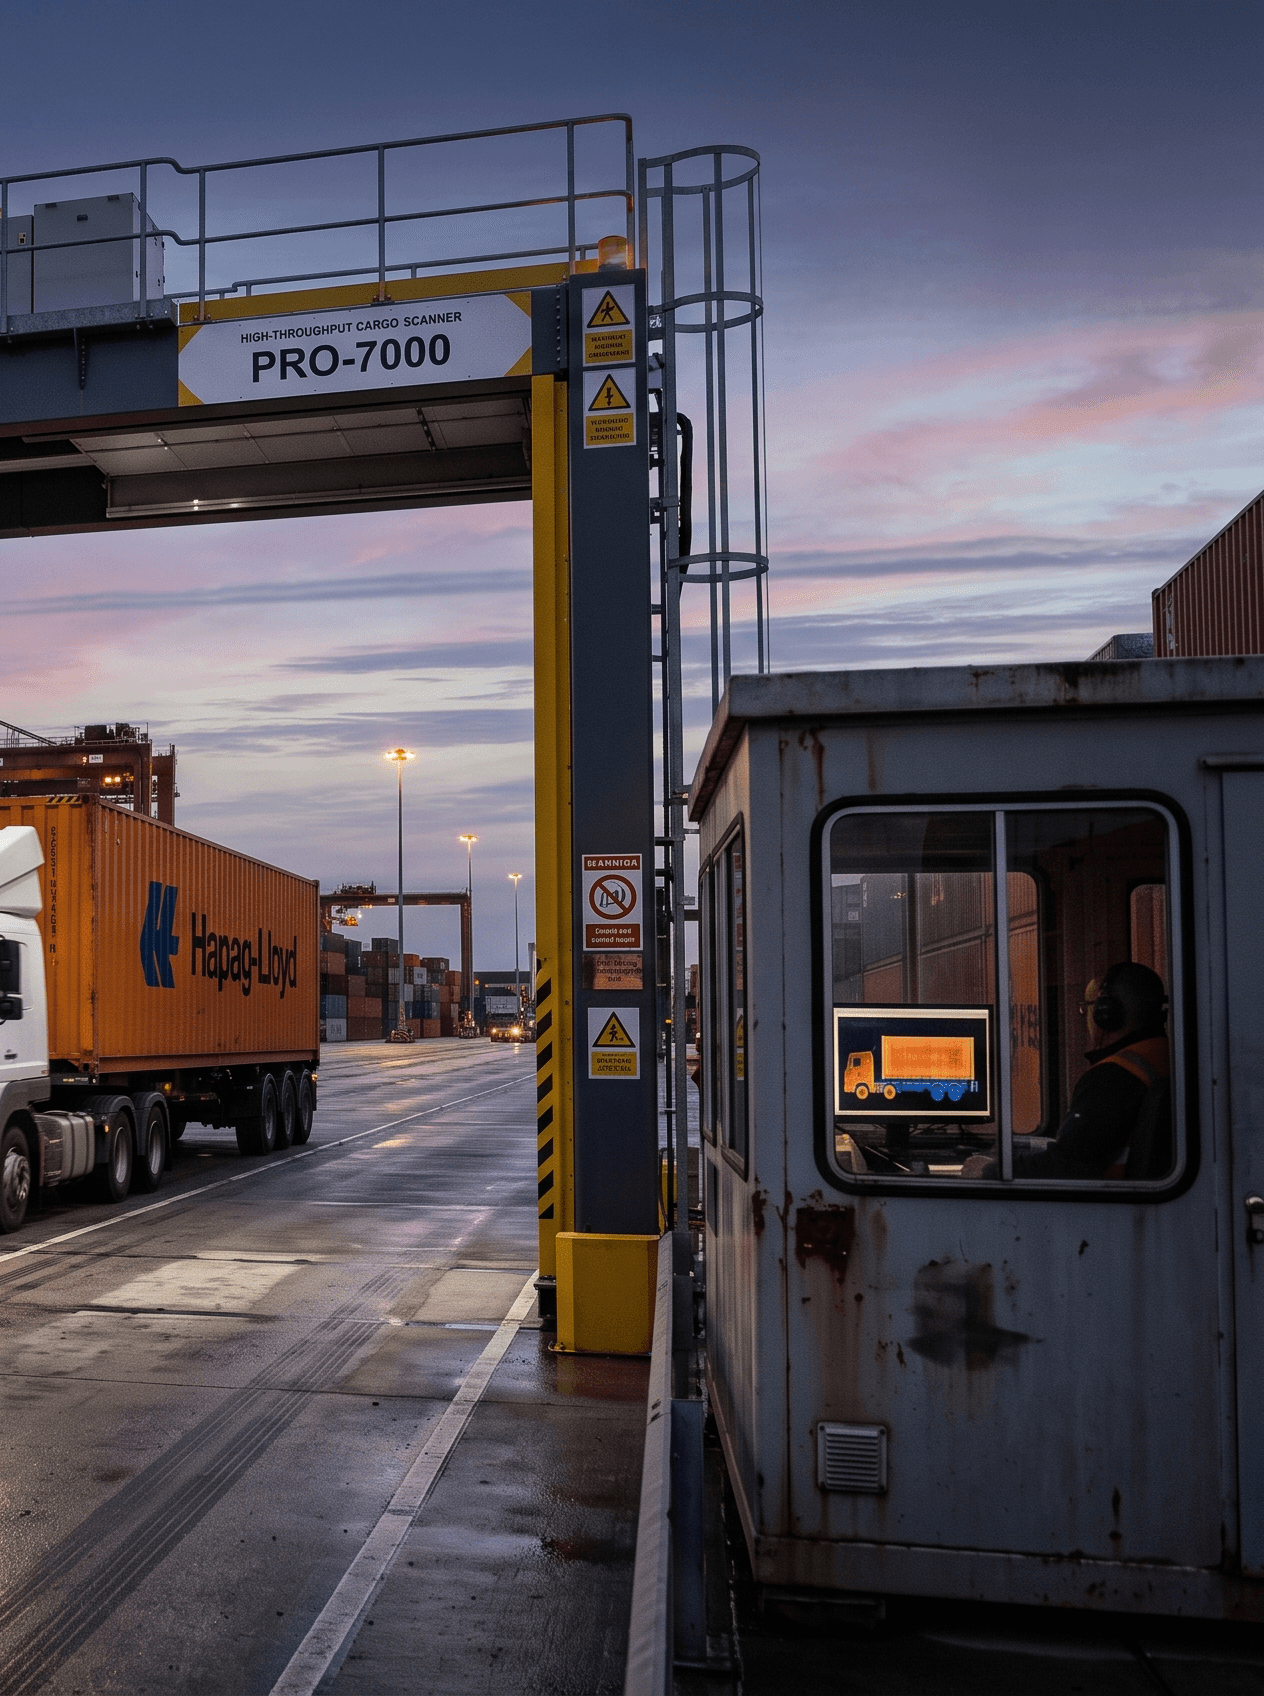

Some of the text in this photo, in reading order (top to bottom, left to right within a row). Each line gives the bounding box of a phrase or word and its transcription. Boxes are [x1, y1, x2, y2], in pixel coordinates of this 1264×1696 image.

[240, 311, 463, 344] HIGH-THROUGHPUT CARGO SCANNER
[251, 333, 452, 383] PRO-7000
[191, 912, 297, 999] Hapag-Lloyd
